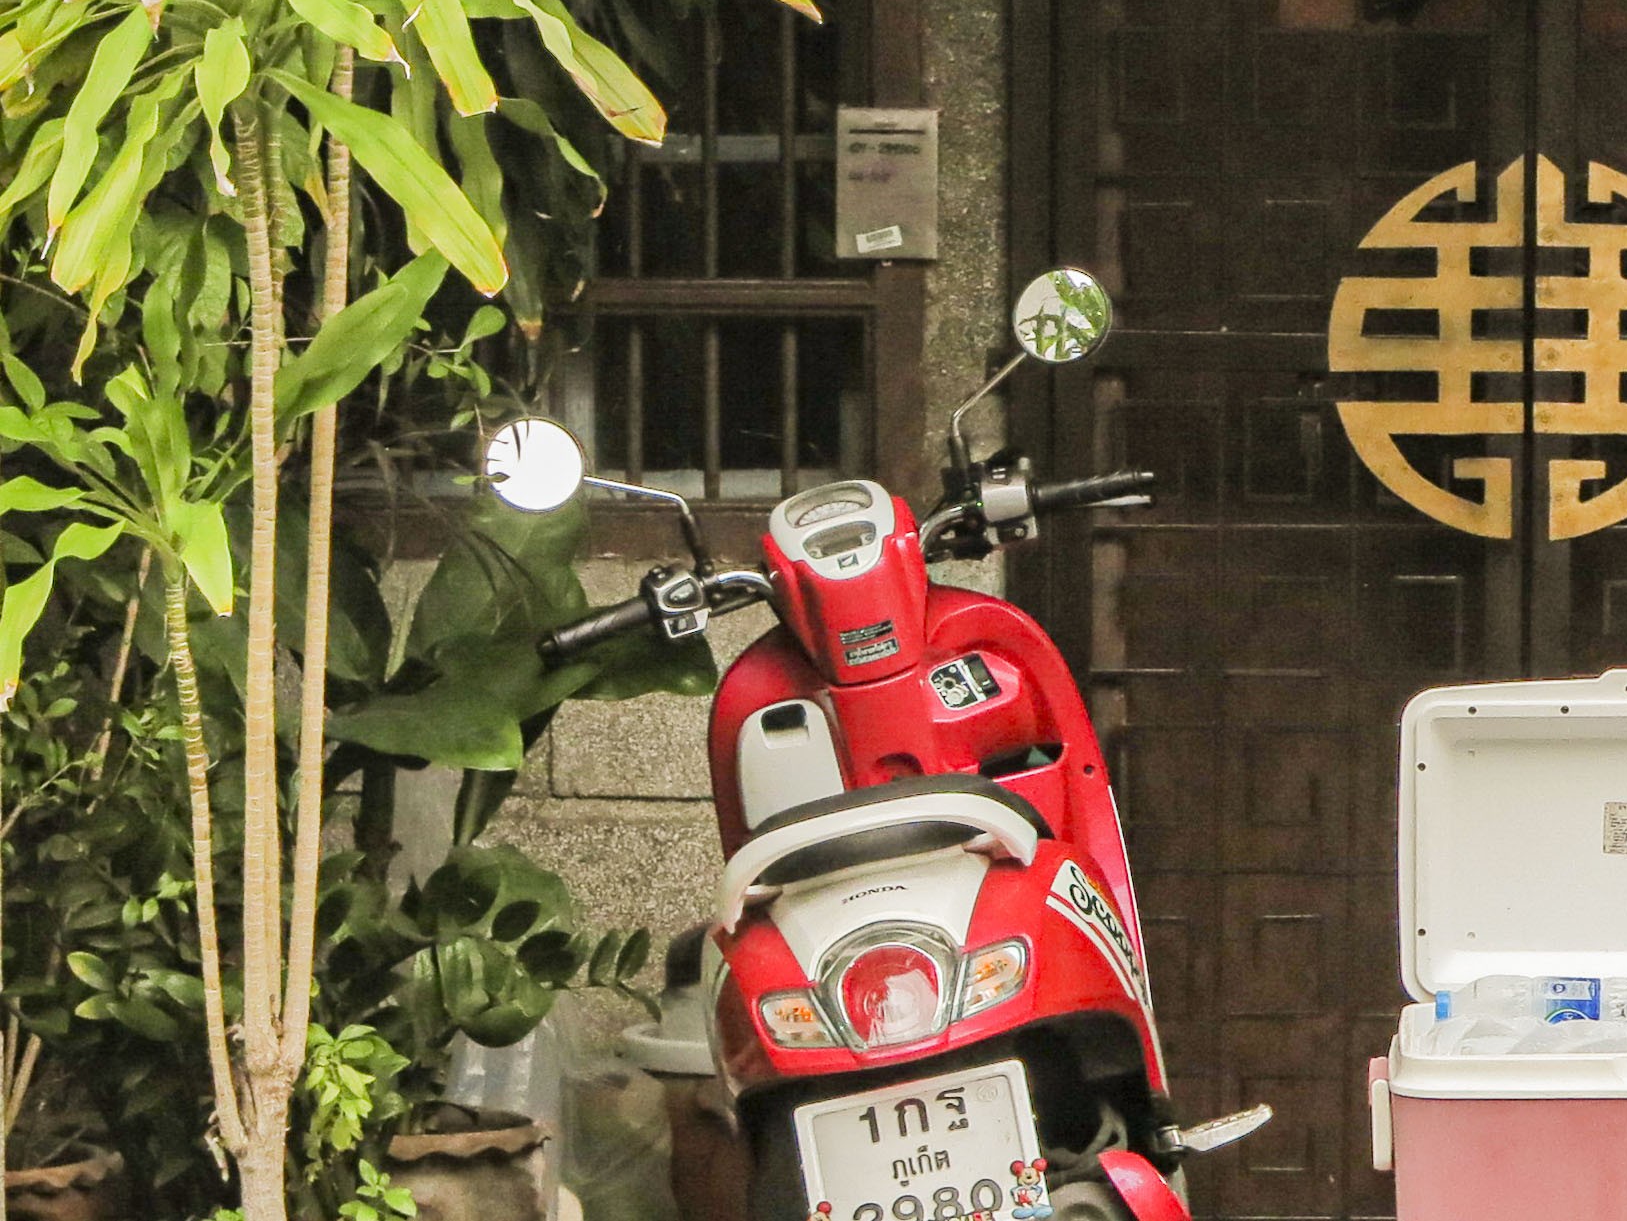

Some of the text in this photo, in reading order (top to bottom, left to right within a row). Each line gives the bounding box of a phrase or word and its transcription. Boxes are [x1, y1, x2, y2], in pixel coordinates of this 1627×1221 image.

[841, 885, 907, 905] HONDA
[892, 1145, 950, 1186] ภูเก็ต
